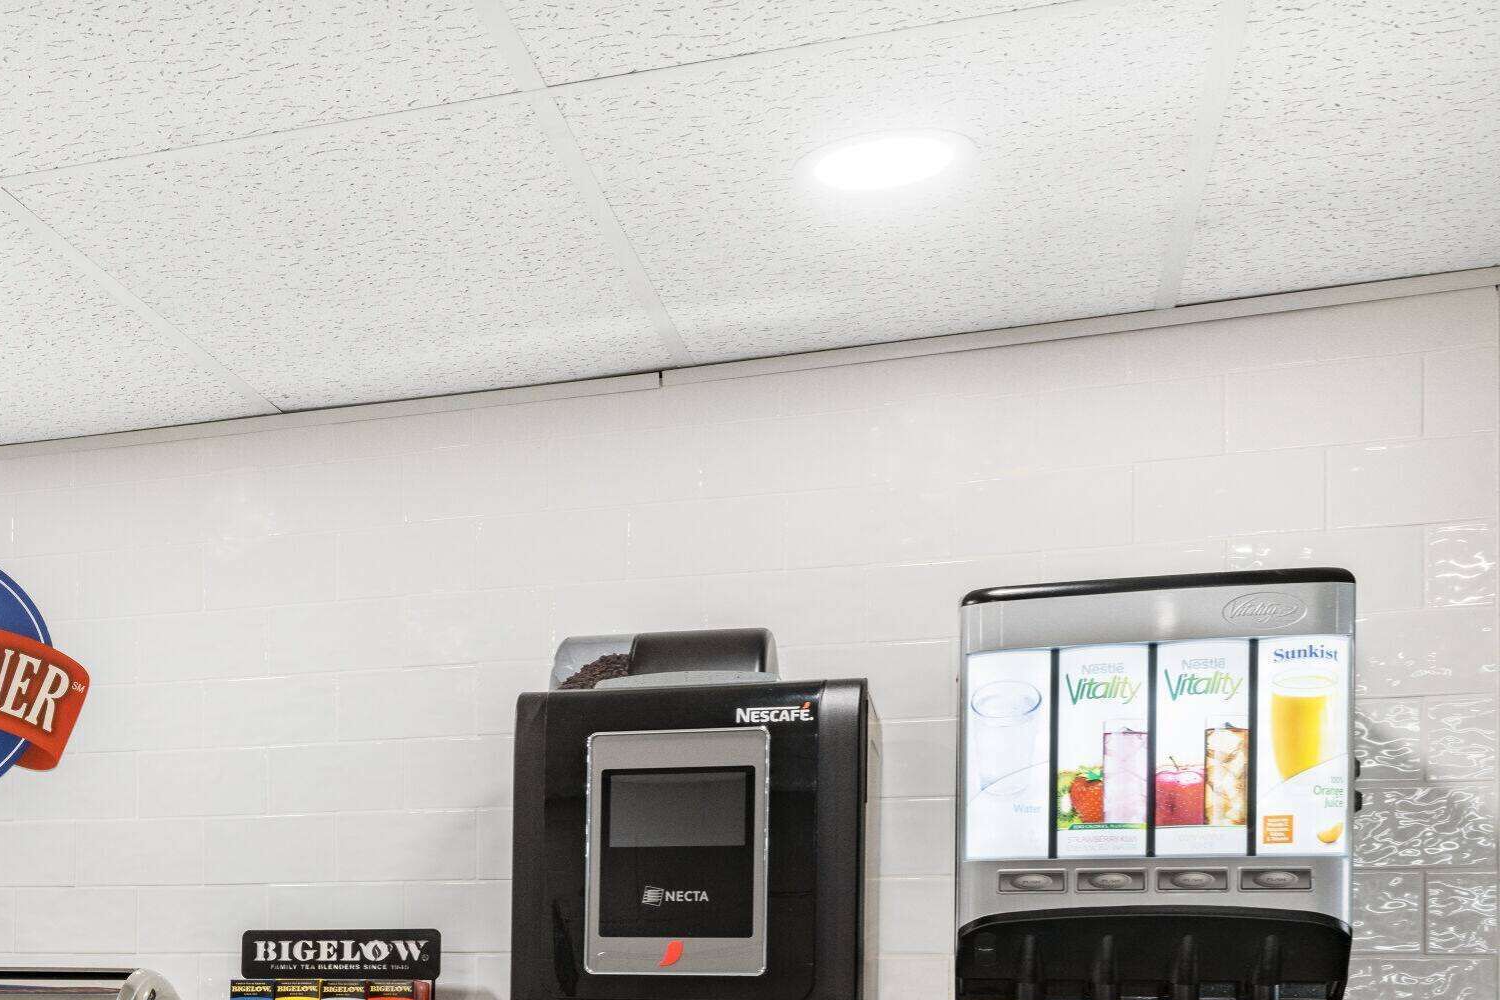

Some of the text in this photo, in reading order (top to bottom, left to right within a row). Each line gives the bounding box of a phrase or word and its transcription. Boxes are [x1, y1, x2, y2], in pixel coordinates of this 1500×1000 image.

[1273, 644, 1339, 663] Sunkist
[1065, 673, 1143, 706] Vitality
[1164, 668, 1244, 702] Vitality
[664, 890, 710, 902] NECTA
[253, 939, 429, 962] BIGELOW
[323, 985, 365, 993] BIGELOW
